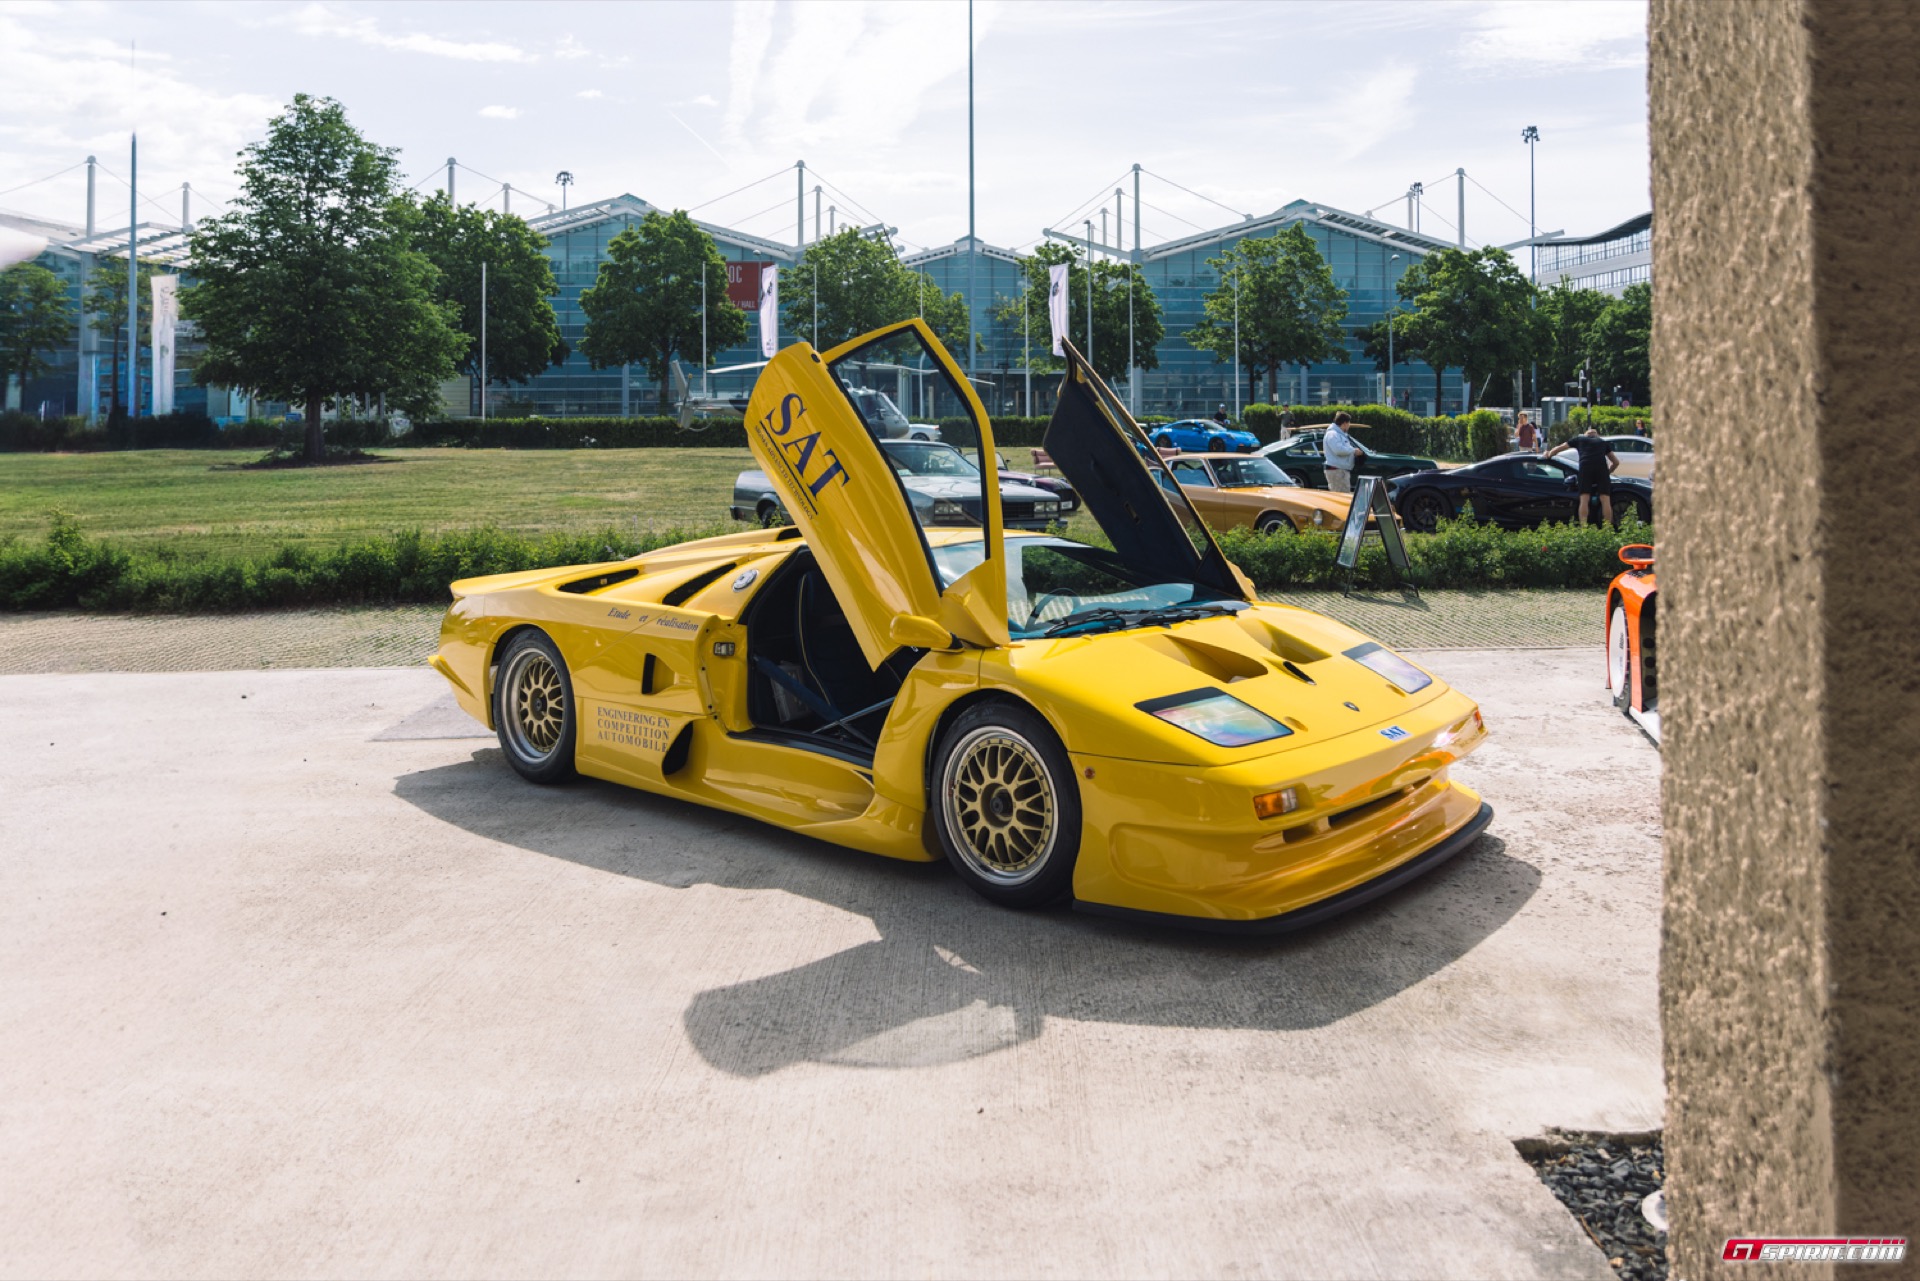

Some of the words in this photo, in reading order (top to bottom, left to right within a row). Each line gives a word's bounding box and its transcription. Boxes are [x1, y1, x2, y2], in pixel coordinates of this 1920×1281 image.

[765, 393, 851, 501] SAT
[767, 446, 789, 479] ADVANCED
[787, 477, 814, 520] TECHNOLOGY
[607, 607, 631, 620] Etude
[638, 614, 649, 623] et
[656, 615, 699, 632] réalisation
[597, 706, 656, 726] ENGINEERING
[657, 716, 671, 728] EN
[597, 718, 670, 740] COMPETITION
[1380, 725, 1406, 739] SAT
[597, 730, 668, 753] AUTOMOBILE
